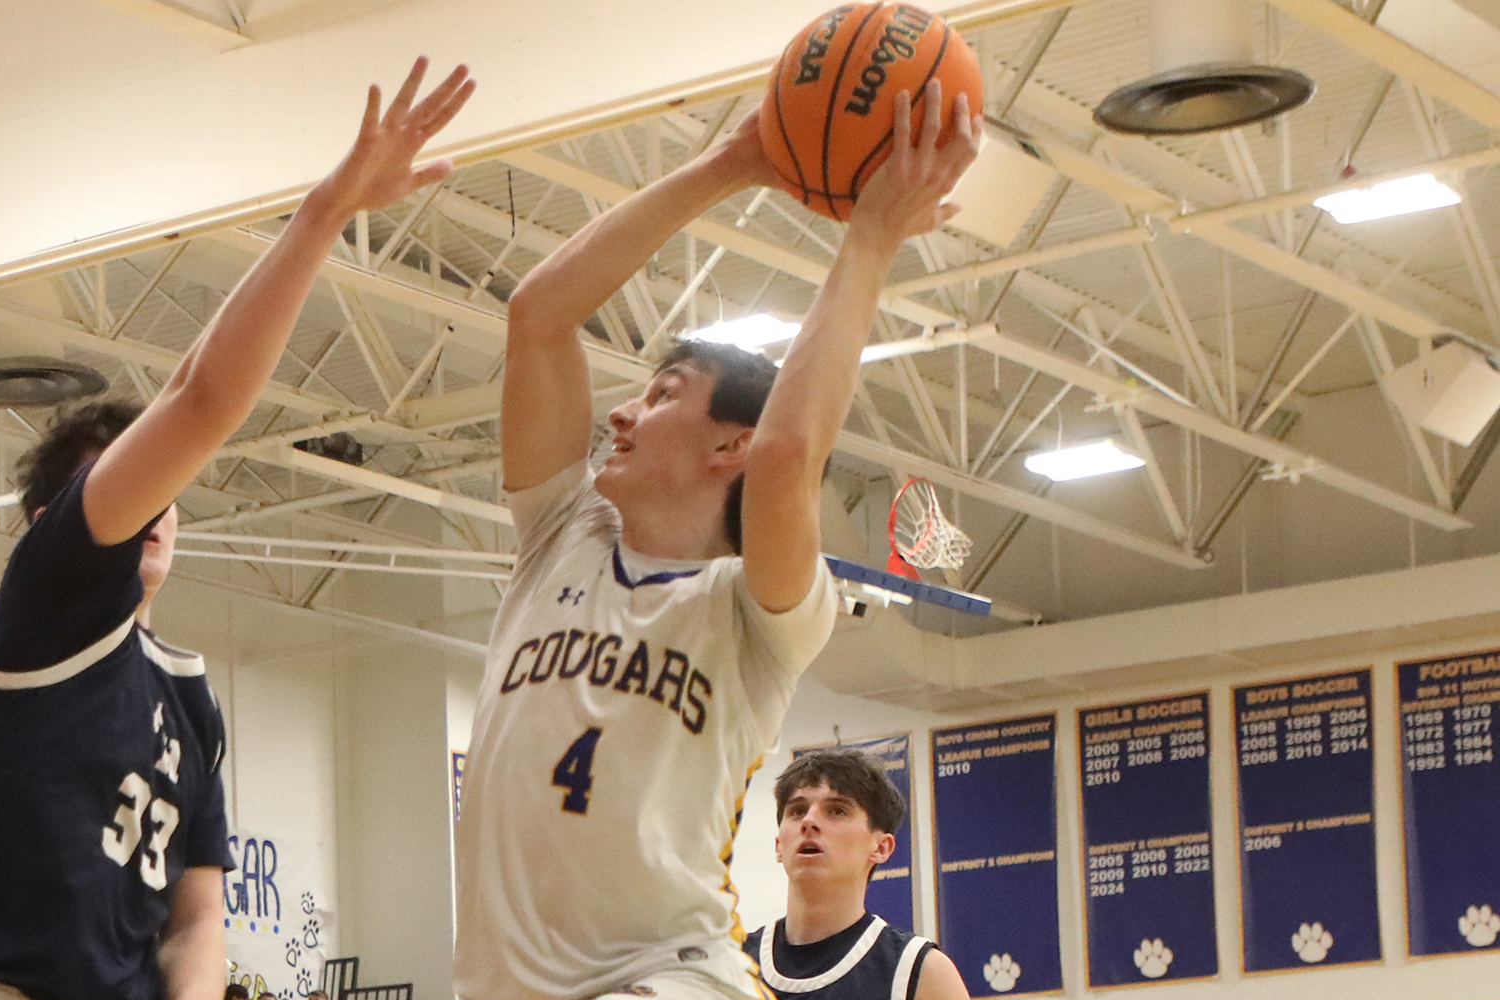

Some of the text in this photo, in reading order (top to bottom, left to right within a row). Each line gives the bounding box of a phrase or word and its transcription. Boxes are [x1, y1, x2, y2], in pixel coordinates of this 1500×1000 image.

[842, 4, 933, 118] Wilson
[500, 628, 713, 735] COUGARS
[1246, 677, 1358, 705] BOYS SOCCER
[1085, 699, 1203, 728] GIRLS SOCCER
[1085, 742, 1119, 758] 2000
[1127, 736, 1162, 752] 2005
[1285, 743, 1323, 760] 2010
[1330, 737, 1368, 754] 2014
[551, 727, 603, 817] 4
[938, 762, 971, 777] 2010
[1086, 757, 1120, 773] 2007
[1086, 770, 1120, 786] 2010
[100, 771, 180, 892] 33
[1090, 854, 1124, 869] 2005
[1132, 863, 1167, 879] 2010
[1175, 858, 1210, 874] 2022
[1090, 881, 1125, 897] 2024
